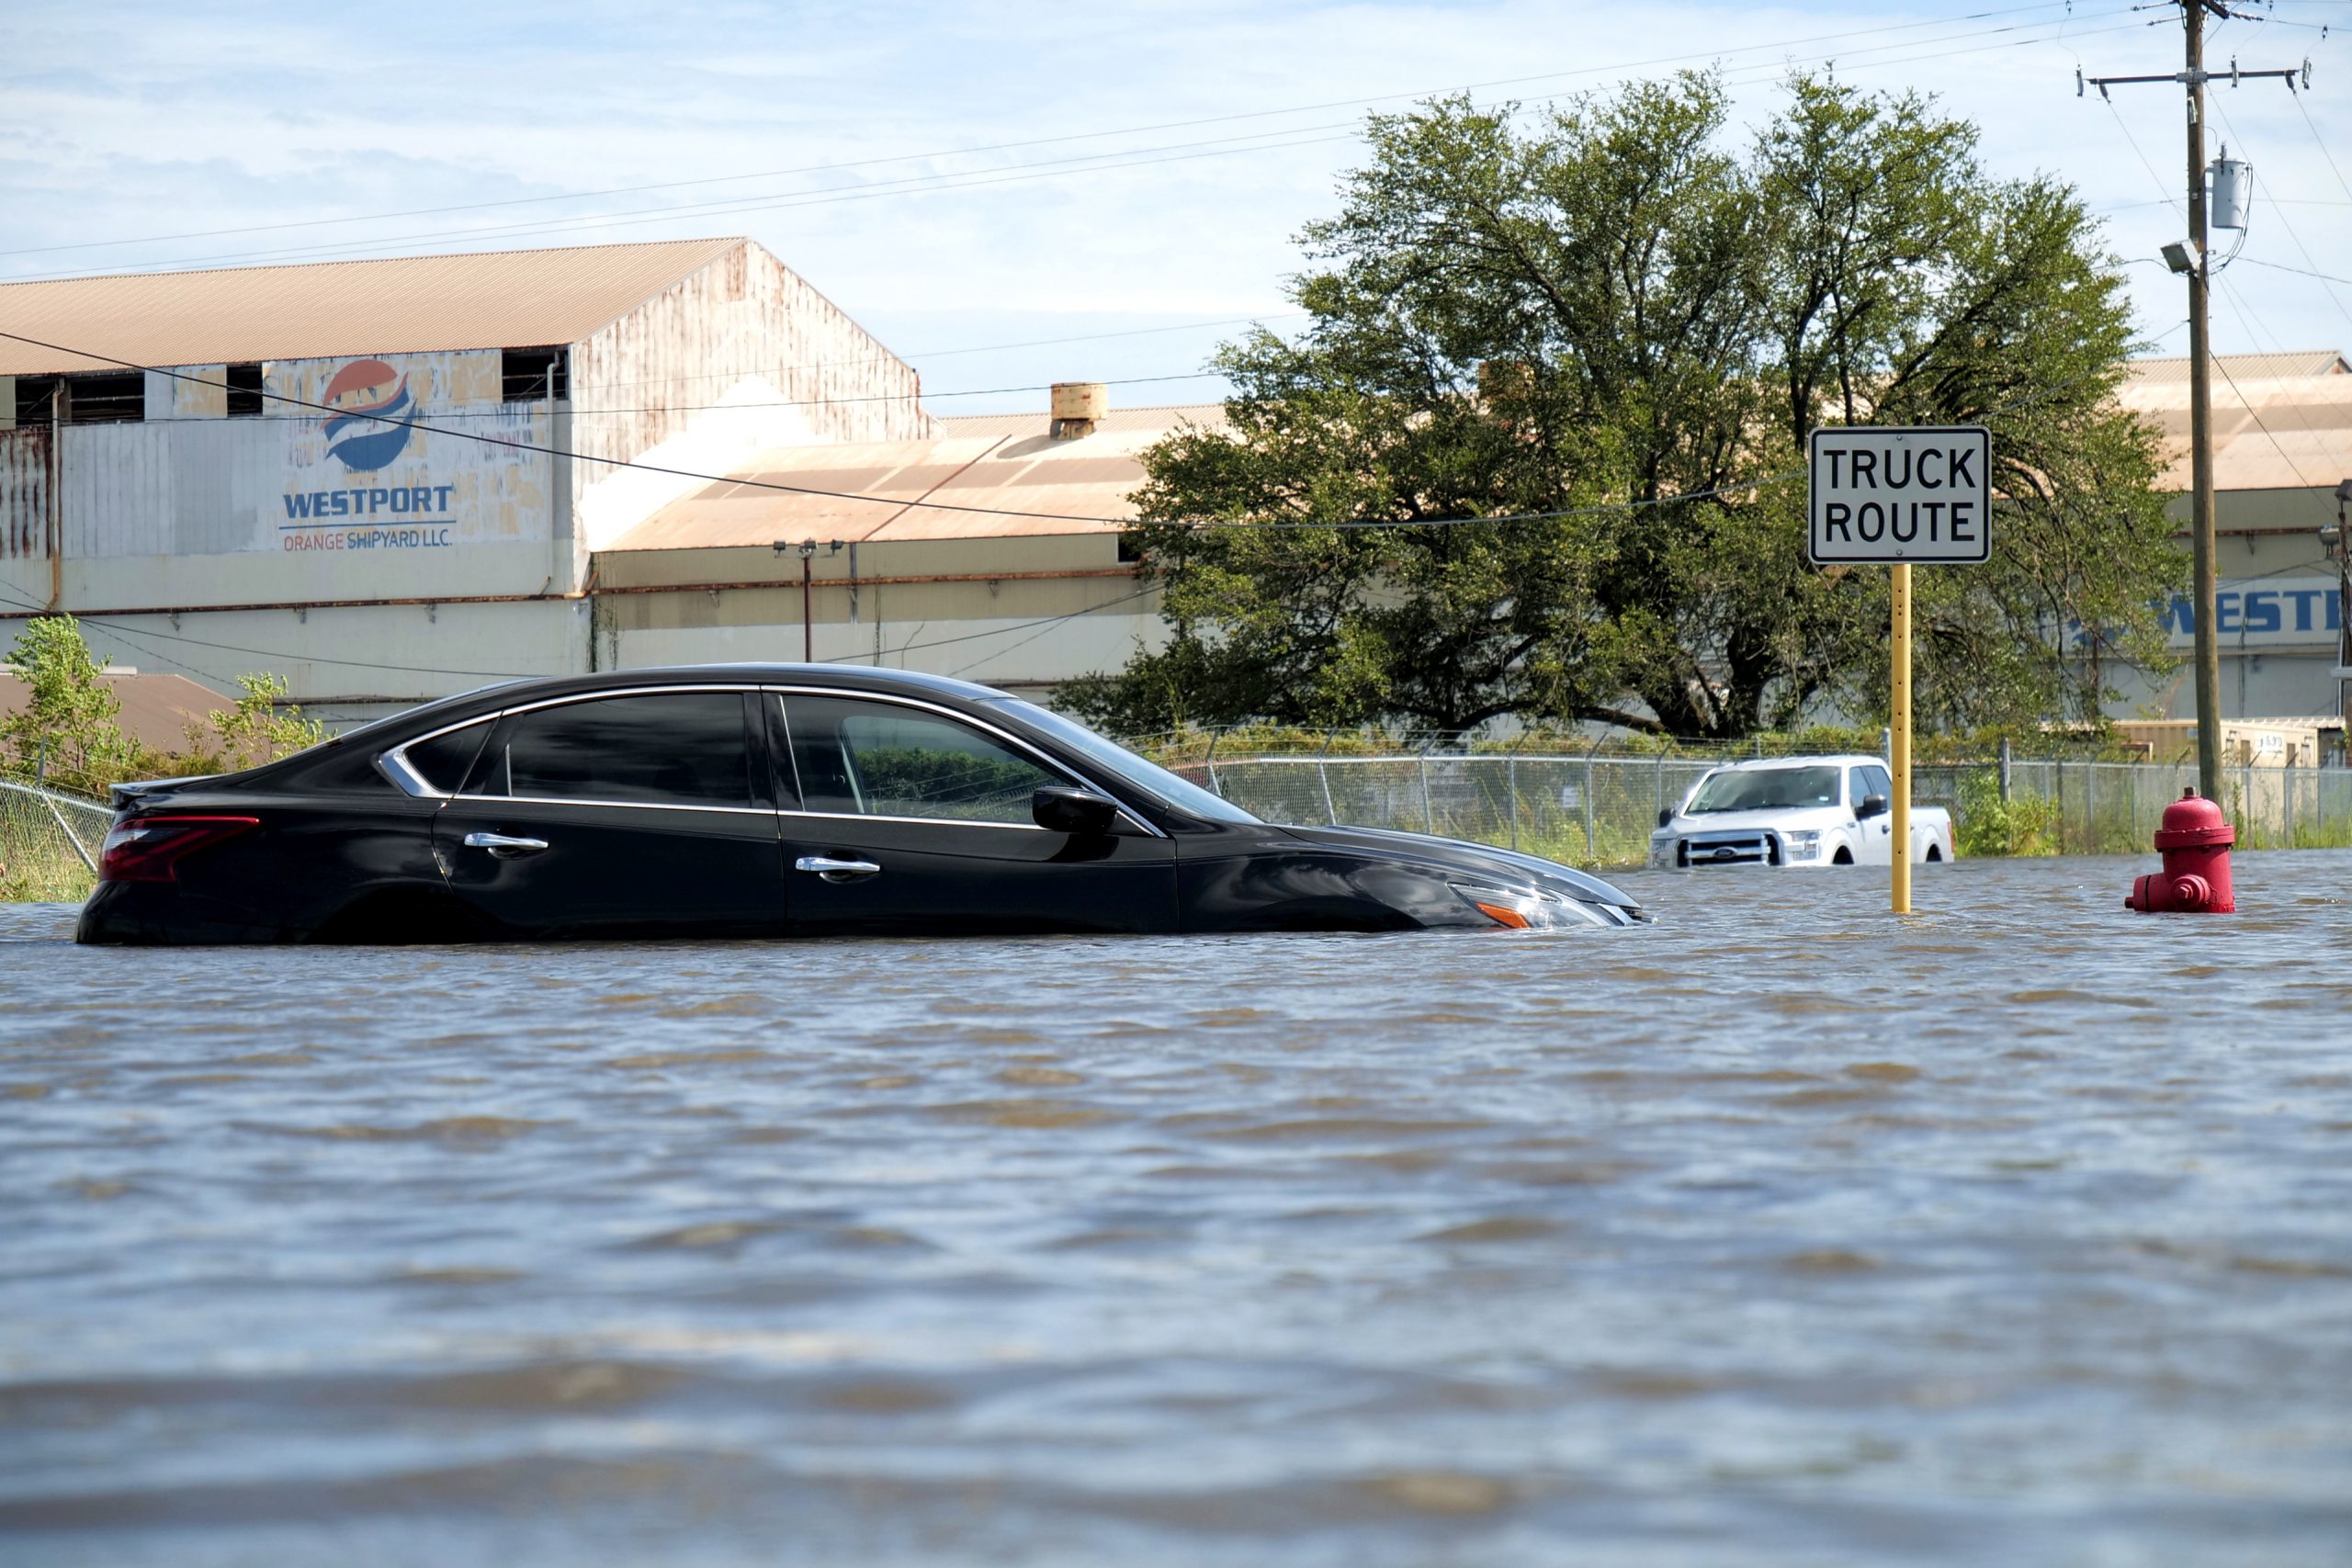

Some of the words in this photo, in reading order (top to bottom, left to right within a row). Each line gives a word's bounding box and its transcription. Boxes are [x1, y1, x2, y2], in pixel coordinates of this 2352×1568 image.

[1823, 448, 1976, 490] TRUCK
[283, 485, 454, 519] WESTPORT
[284, 533, 345, 552] ORANGE
[346, 530, 420, 549] SHIPYARD
[423, 528, 454, 547] LLC.
[1826, 502, 1975, 543] ROUTE
